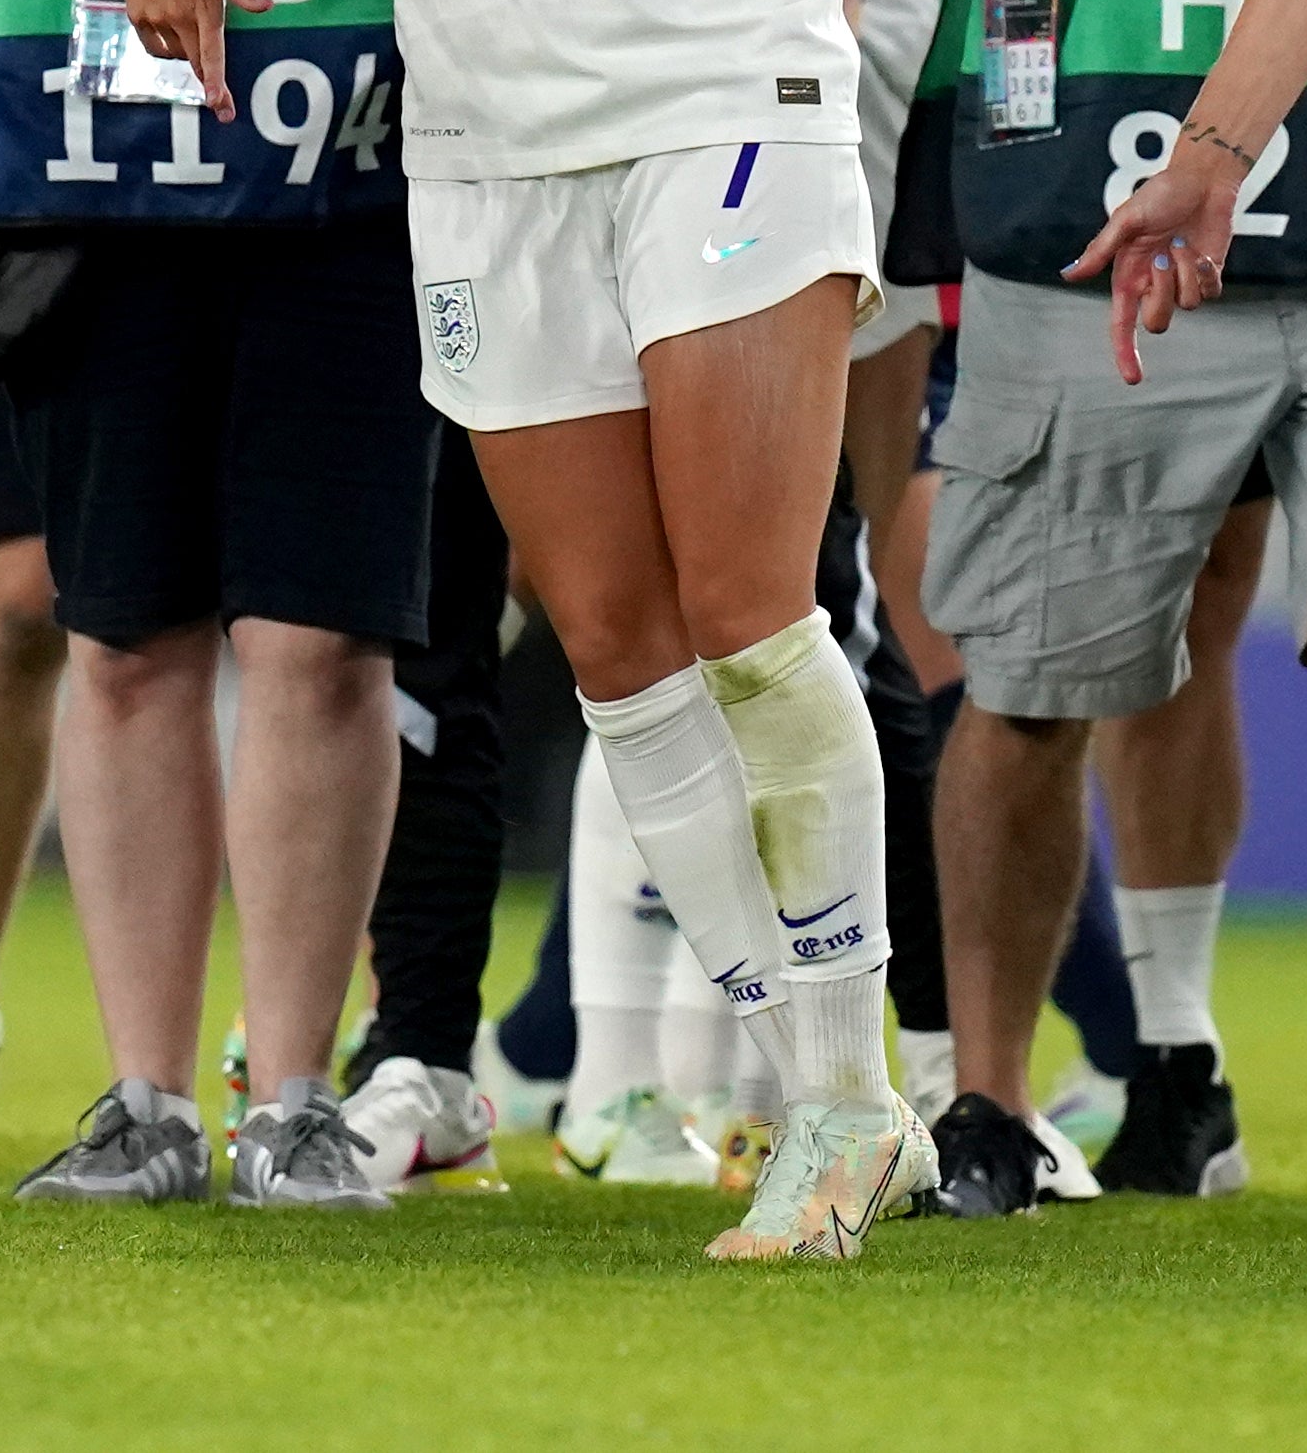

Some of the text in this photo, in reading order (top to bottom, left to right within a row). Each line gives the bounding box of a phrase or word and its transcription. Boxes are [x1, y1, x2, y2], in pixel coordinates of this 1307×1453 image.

[42, 52, 392, 187] 1194
[792, 923, 864, 958] Eng
[723, 980, 768, 1003] ng
